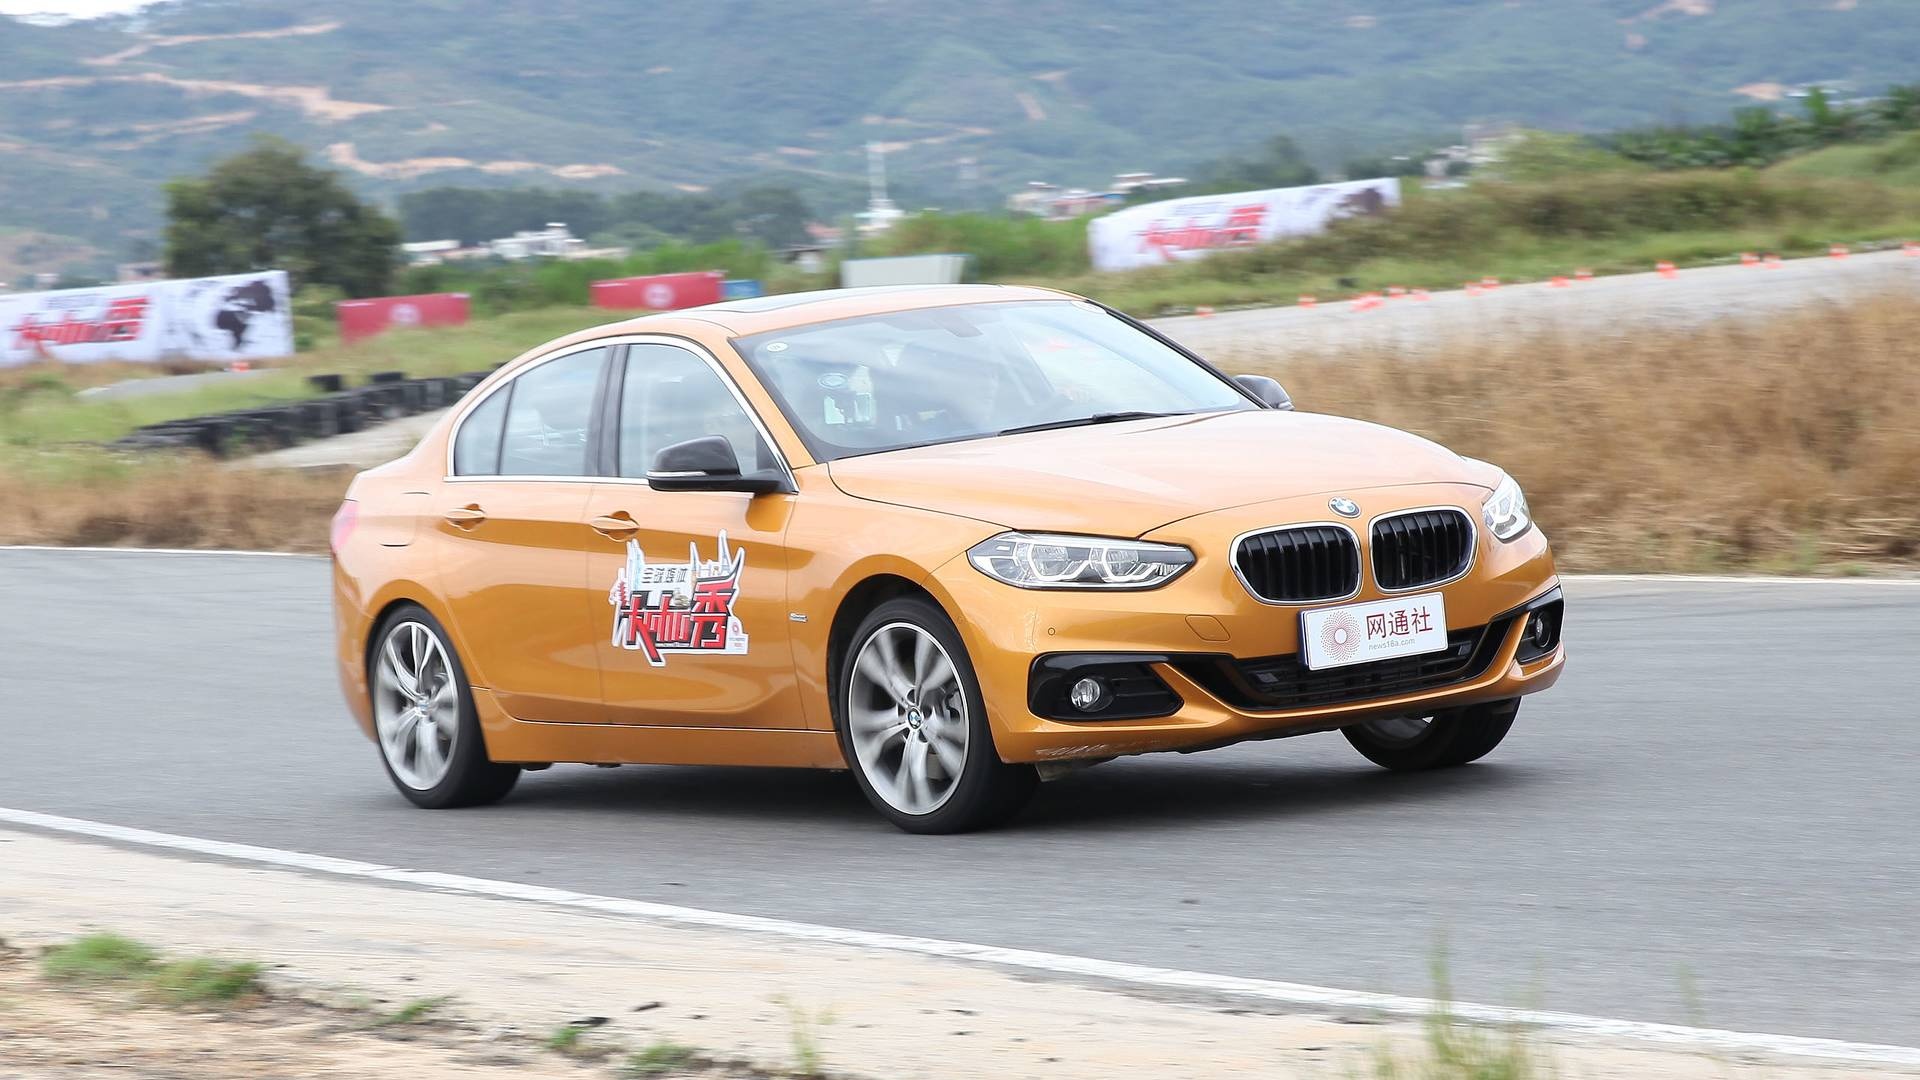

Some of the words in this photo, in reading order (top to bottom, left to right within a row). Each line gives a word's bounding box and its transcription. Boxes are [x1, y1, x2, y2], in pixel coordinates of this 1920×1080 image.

[1366, 605, 1433, 640] 网通社
[1368, 637, 1416, 651] news18a.com
